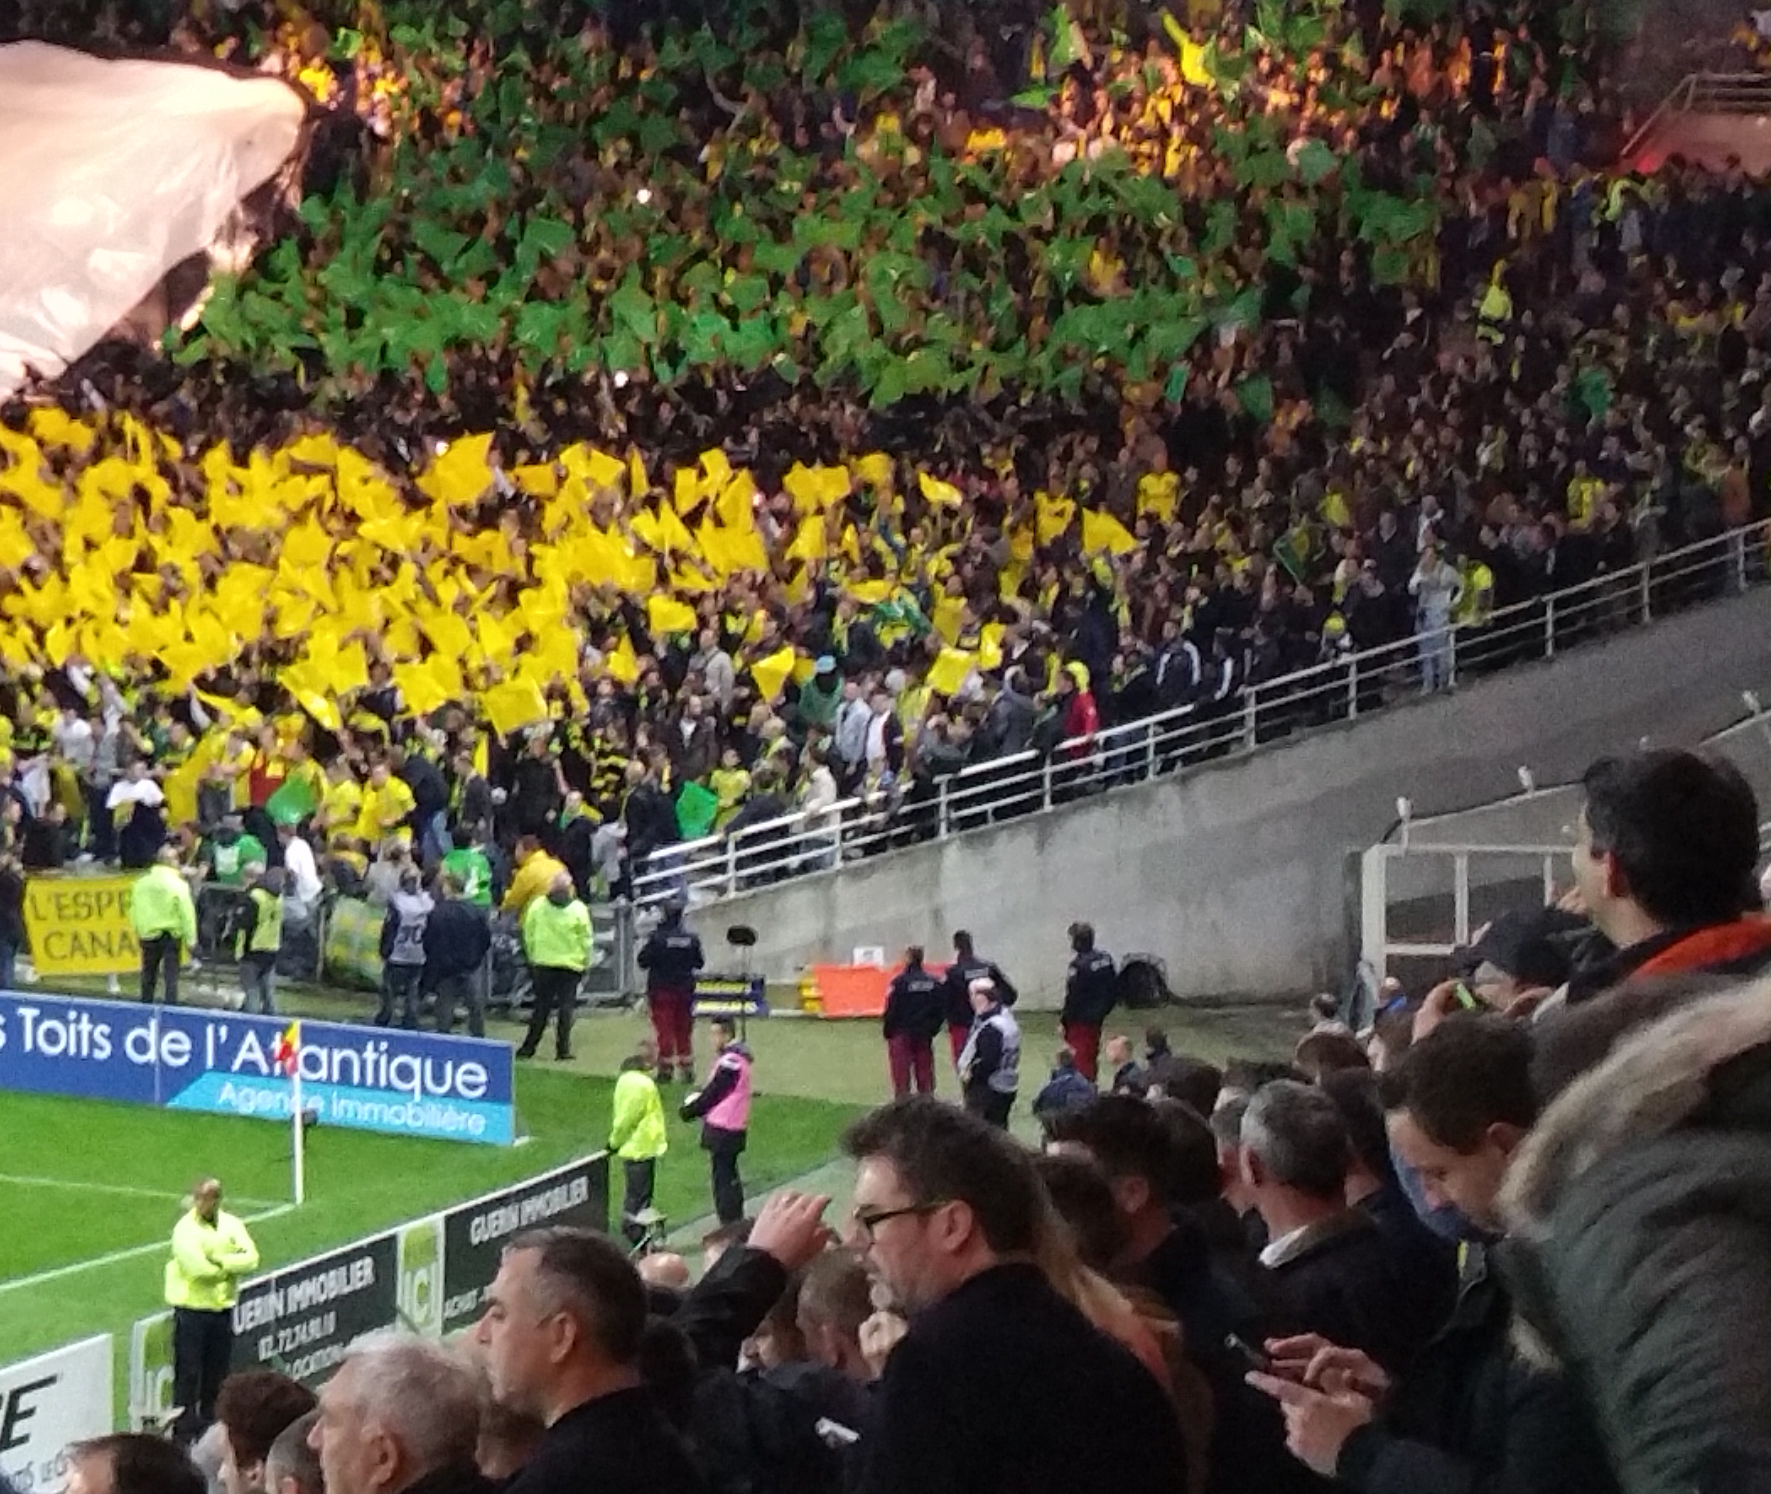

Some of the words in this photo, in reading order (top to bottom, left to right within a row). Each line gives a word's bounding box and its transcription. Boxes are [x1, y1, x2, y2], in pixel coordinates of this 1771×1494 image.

[43, 929, 138, 961] CANA
[16, 1006, 112, 1061] Toits
[124, 1017, 192, 1067] de
[205, 1022, 488, 1101] l'Atantique
